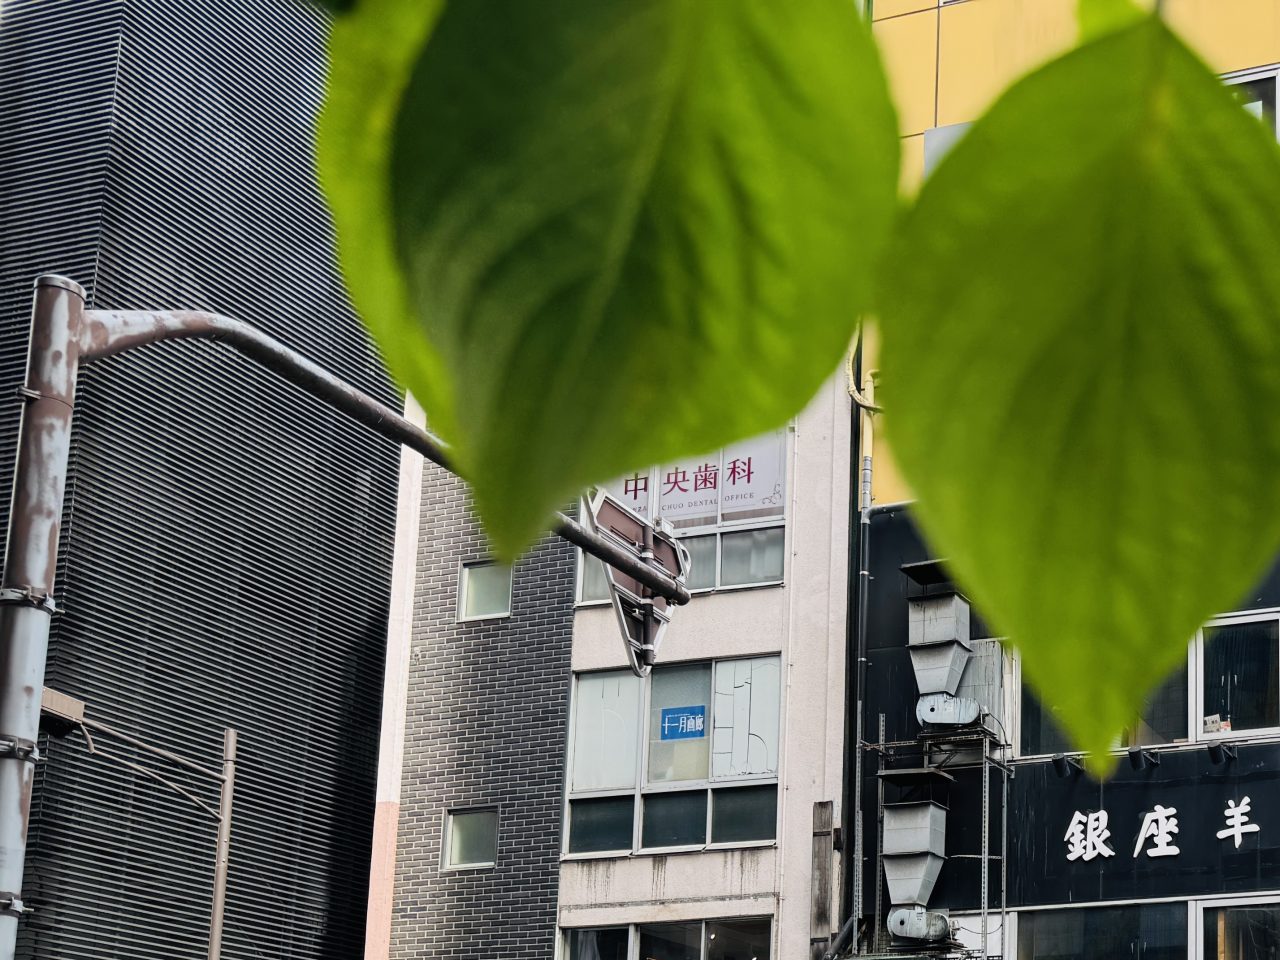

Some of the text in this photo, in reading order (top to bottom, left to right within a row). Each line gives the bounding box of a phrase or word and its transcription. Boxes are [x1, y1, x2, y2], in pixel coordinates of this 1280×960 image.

[624, 456, 754, 500] 中央歯科
[661, 503, 684, 511] CHUO
[688, 500, 718, 509] DENTAL
[724, 492, 755, 501] OFFICE
